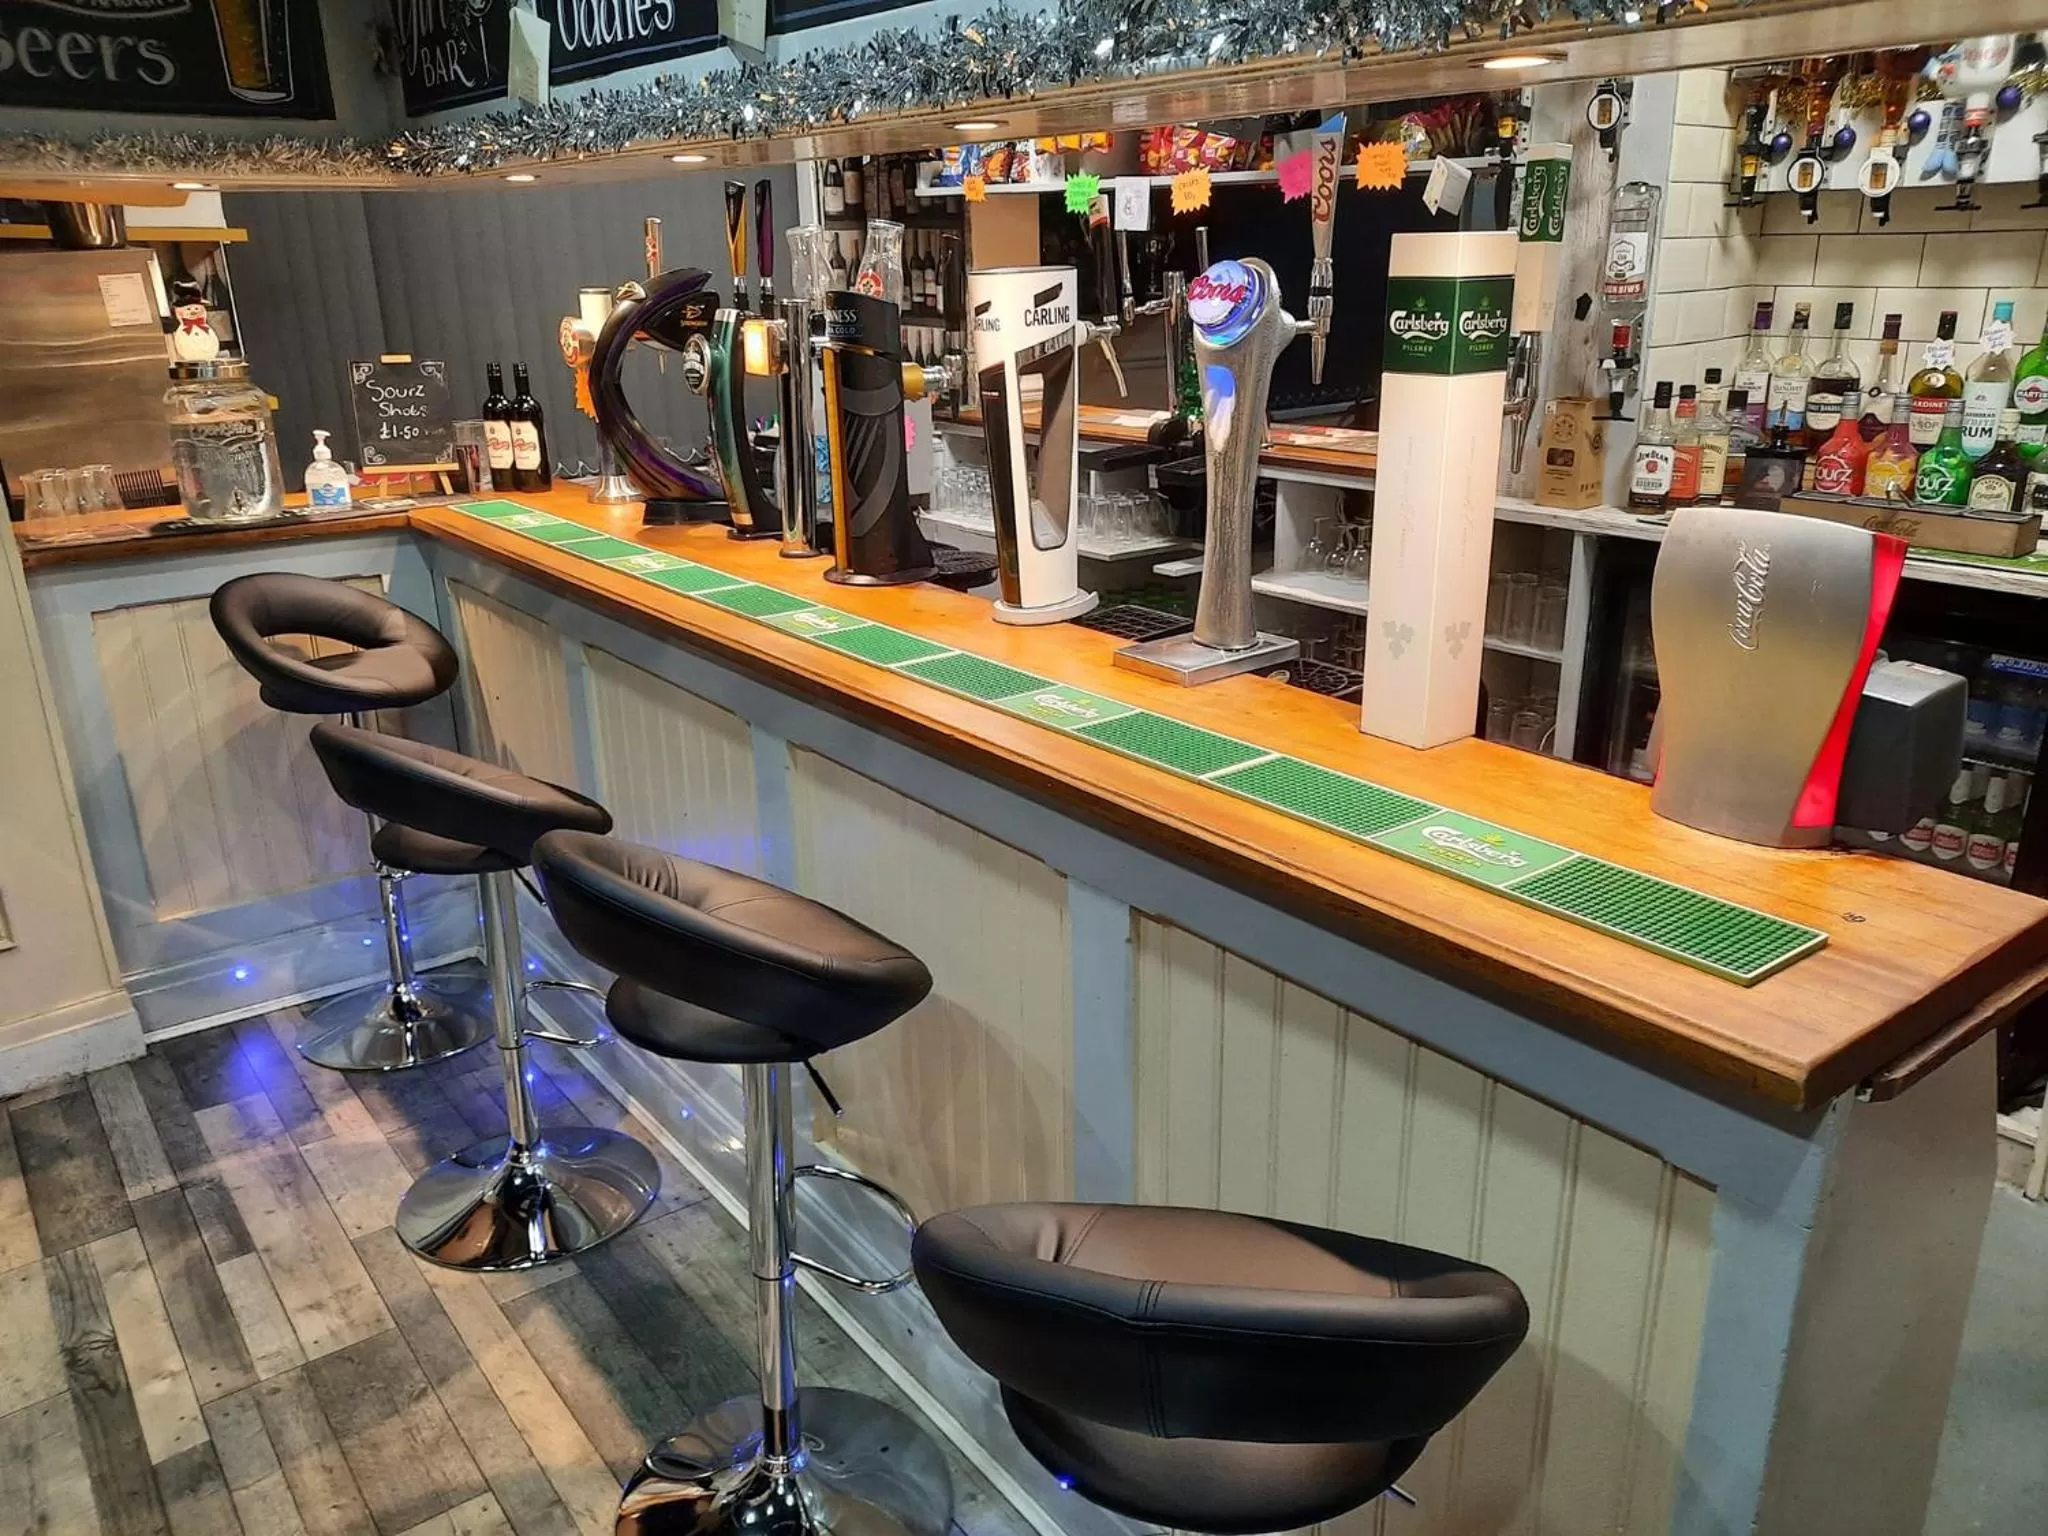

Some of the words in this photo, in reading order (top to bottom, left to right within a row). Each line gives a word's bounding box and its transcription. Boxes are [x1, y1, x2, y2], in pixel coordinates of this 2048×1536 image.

[421, 39, 476, 88] BAR
[1311, 136, 1337, 222] Coors
[1521, 165, 1546, 236] Carlsberg
[1186, 275, 1247, 303] Coors
[1024, 305, 1070, 327] CARLING
[1389, 310, 1449, 340] Carlsberg
[1459, 309, 1508, 340] Carlsberg
[365, 379, 425, 402] Sourz
[1961, 426, 1993, 438] RUM
[1421, 826, 1529, 869] Carlsberg
